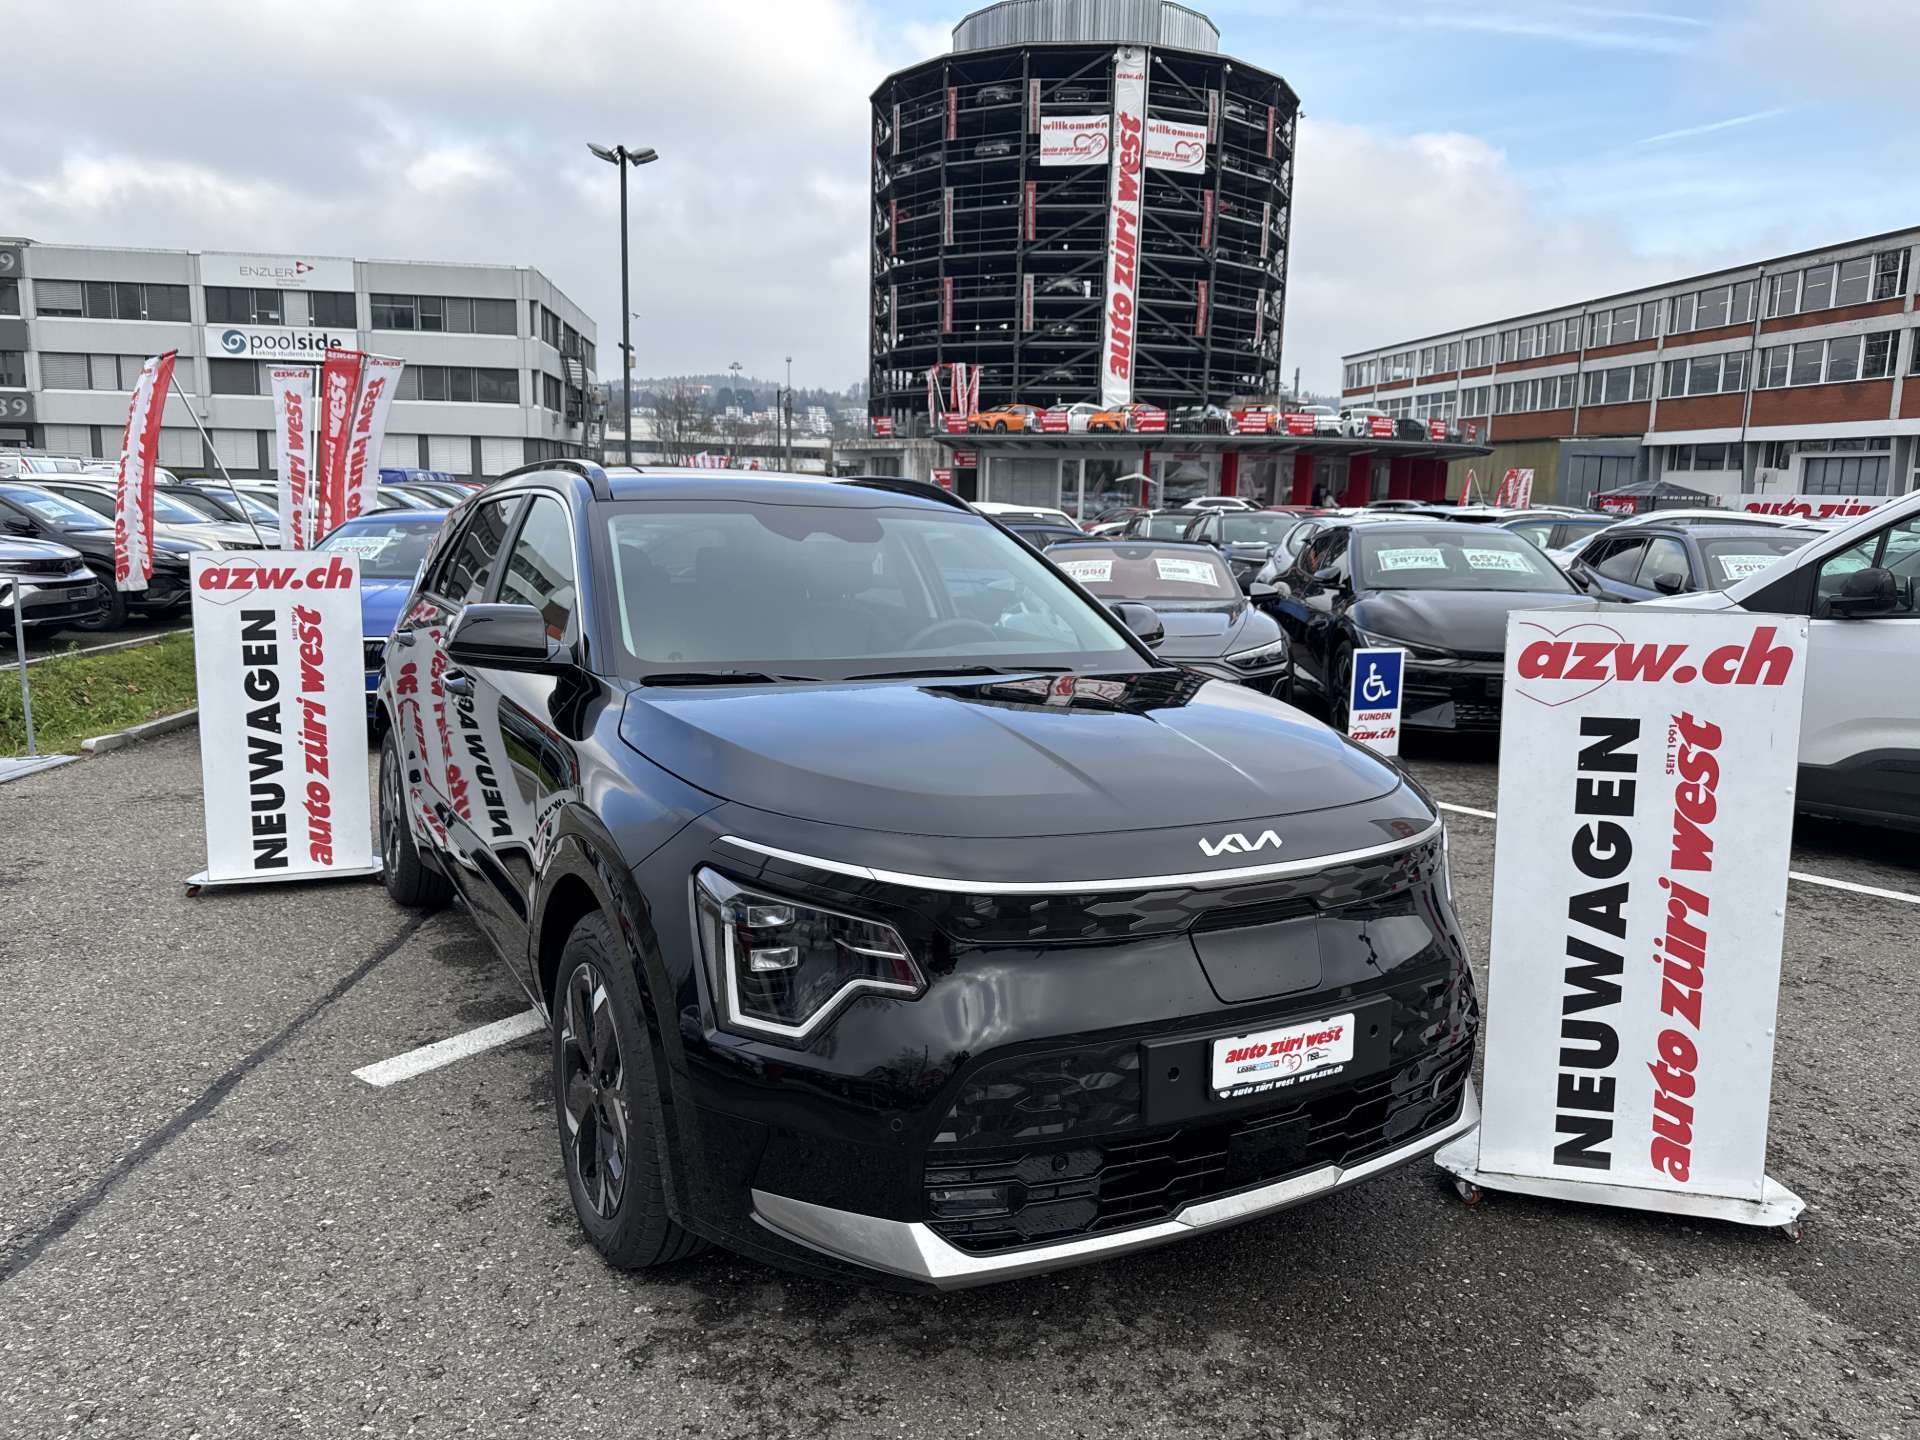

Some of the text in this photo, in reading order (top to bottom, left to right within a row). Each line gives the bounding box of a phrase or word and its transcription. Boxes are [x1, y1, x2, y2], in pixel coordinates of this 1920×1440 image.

[1117, 72, 1144, 81] azw.ch
[1043, 121, 1108, 130] willkommen
[1148, 125, 1205, 138] willkommen
[1109, 111, 1141, 380] auto züri west
[239, 266, 294, 278] ENZLER
[250, 331, 342, 355] poolside
[273, 369, 310, 379] azw.ch
[284, 390, 304, 451] west
[329, 371, 348, 438] west
[287, 452, 306, 506] züri
[199, 557, 353, 590] azw.ch
[1517, 626, 1794, 686] azw.ch
[291, 604, 333, 866] auto züri west
[1351, 728, 1397, 740] azw.ch
[1358, 711, 1392, 721] KUNDEN
[240, 609, 289, 871] NEUWAGEN
[1666, 724, 1677, 775] SEIT 1991
[1553, 716, 1642, 1171] NEUWAGEN
[1646, 710, 1723, 1183] auto züri west
[1225, 1025, 1344, 1064] auto züri west
[1232, 1085, 1254, 1097] auto
[1255, 1080, 1274, 1095] züri
[1275, 1077, 1295, 1089] west
